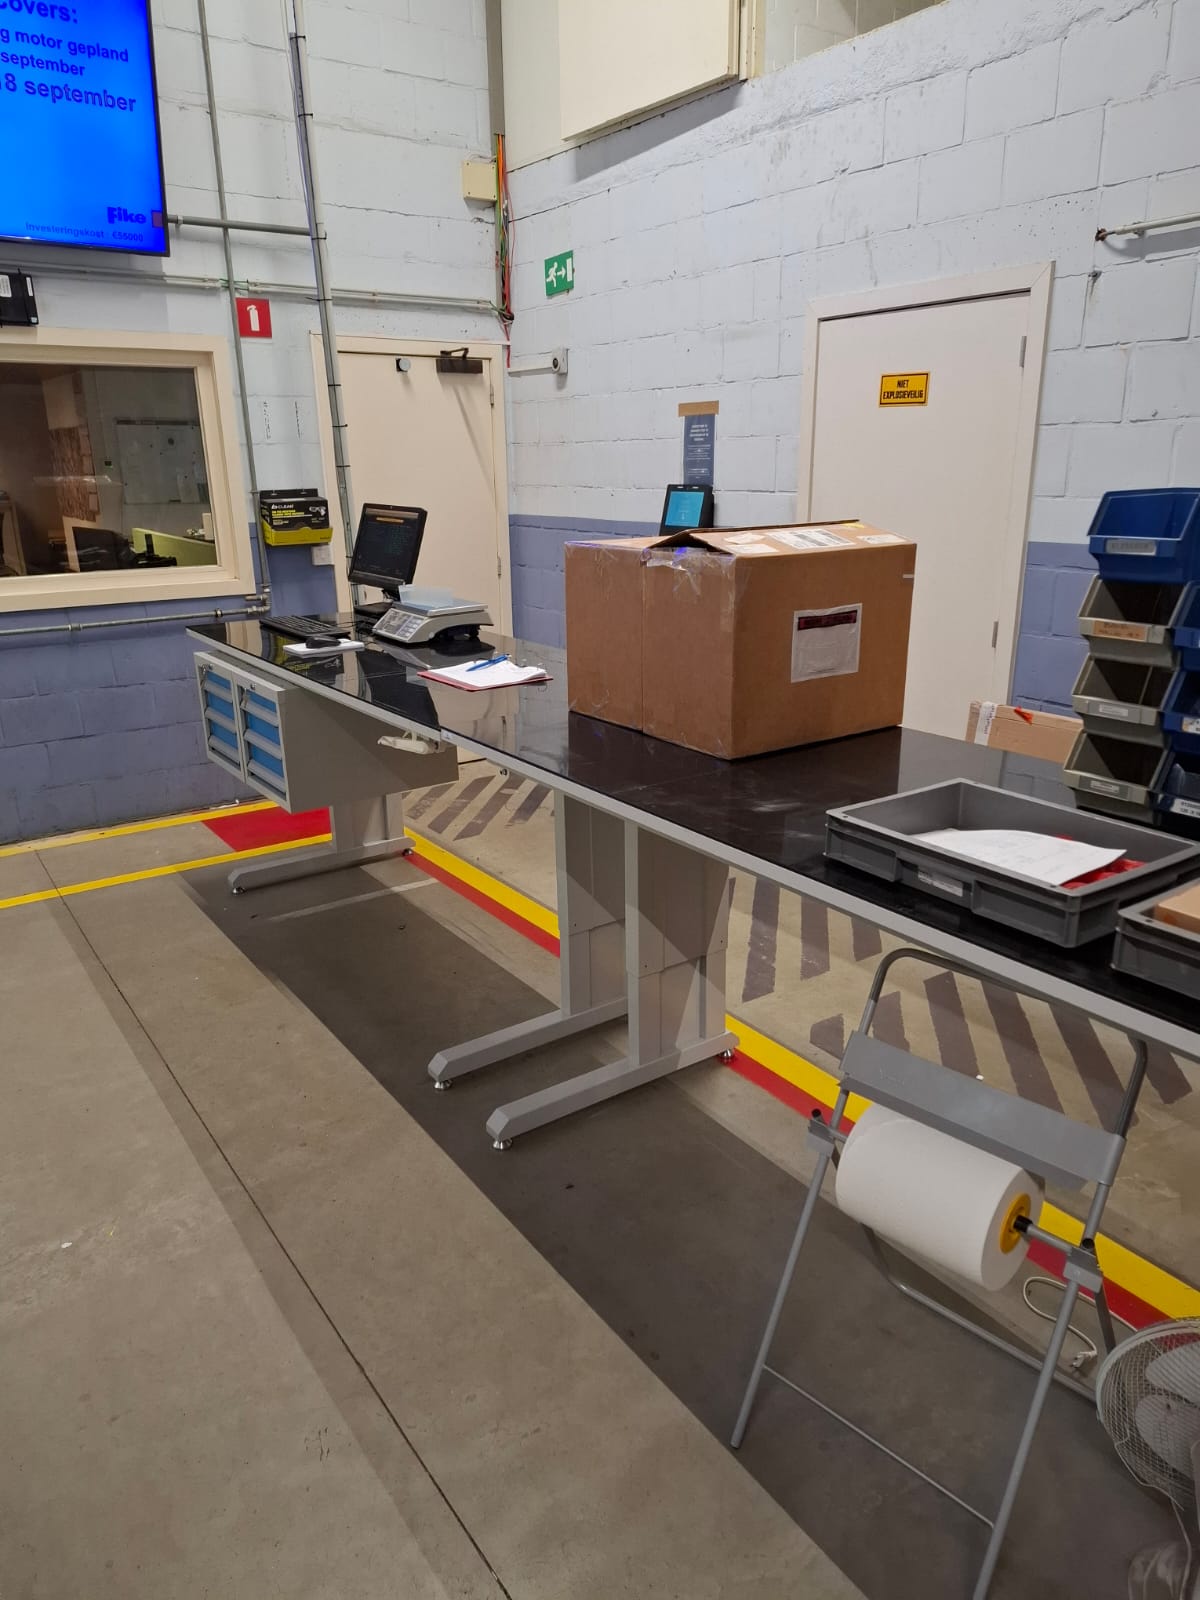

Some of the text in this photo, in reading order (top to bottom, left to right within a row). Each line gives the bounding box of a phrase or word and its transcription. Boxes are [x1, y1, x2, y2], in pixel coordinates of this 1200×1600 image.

[15, 31, 63, 50] motor
[67, 40, 129, 62] gepland
[0, 51, 85, 76] september
[24, 80, 136, 112] september
[107, 206, 147, 224] Fike
[897, 379, 909, 388] NIET
